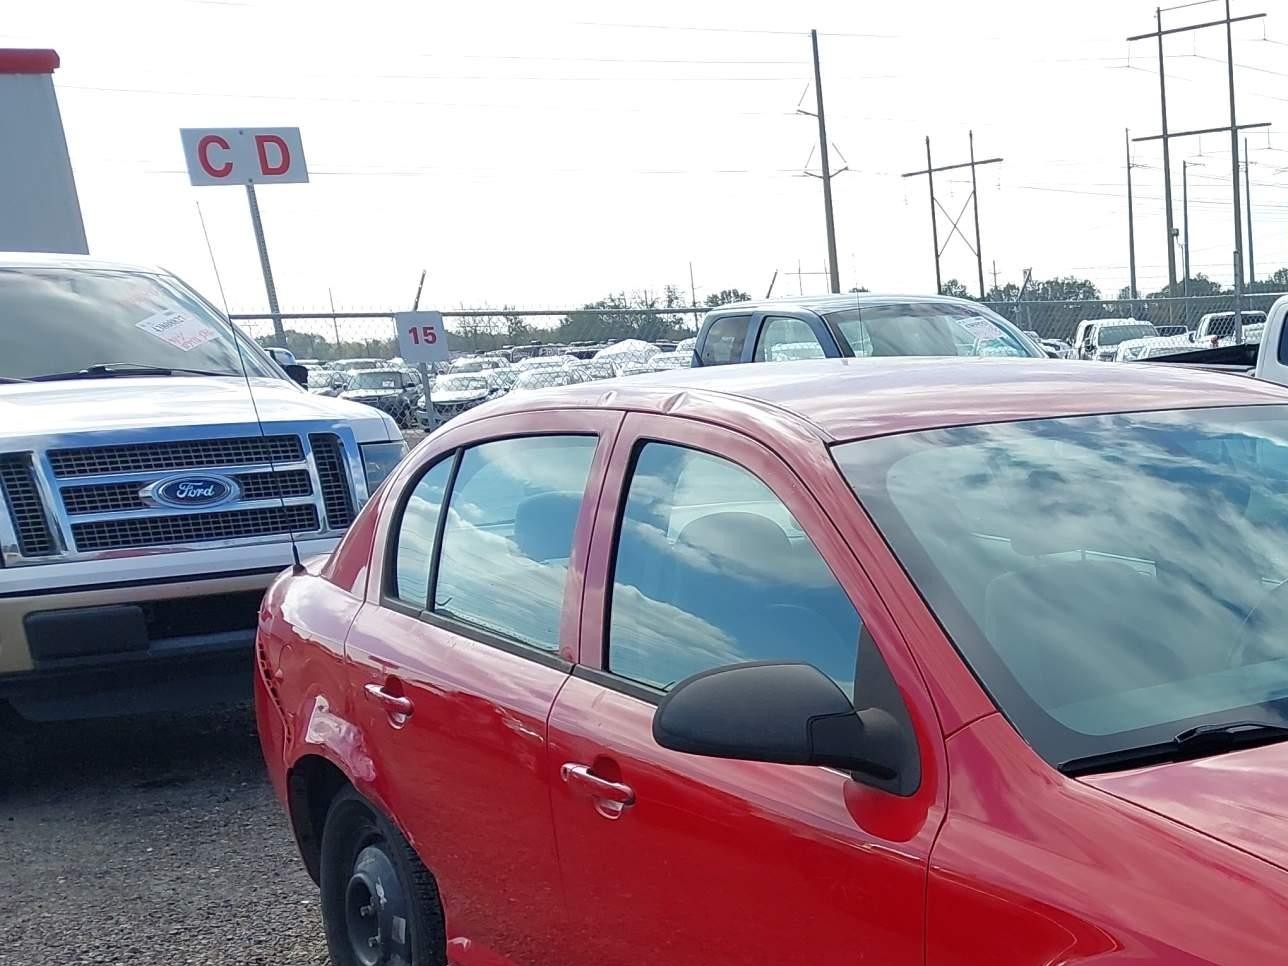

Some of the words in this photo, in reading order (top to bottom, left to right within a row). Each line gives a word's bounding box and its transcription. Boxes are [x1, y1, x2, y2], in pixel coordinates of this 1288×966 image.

[197, 134, 234, 178] C
[254, 134, 291, 176] D
[408, 326, 438, 345] 15
[176, 481, 215, 498] Ford
